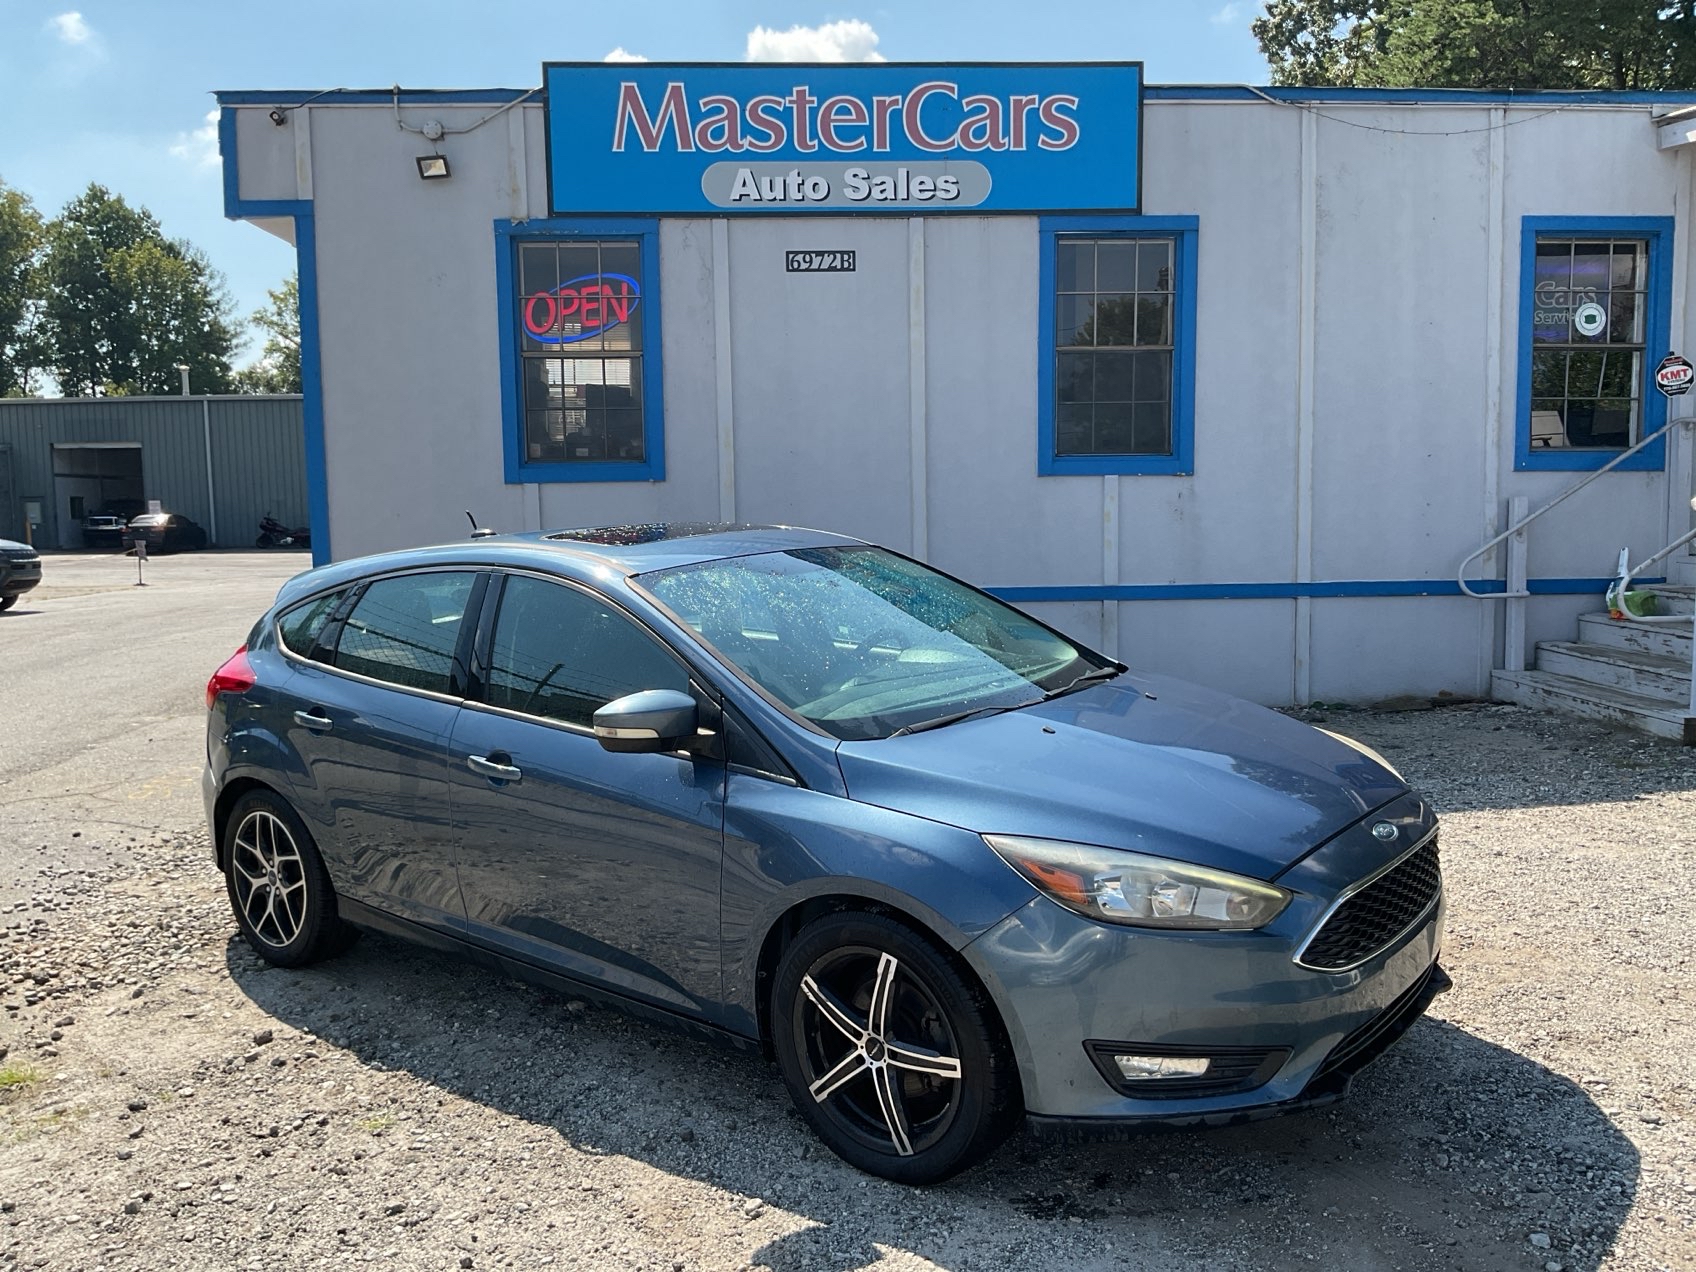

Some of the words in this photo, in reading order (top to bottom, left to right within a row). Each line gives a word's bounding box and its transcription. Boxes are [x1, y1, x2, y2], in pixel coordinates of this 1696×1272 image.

[611, 81, 1080, 153] MasterCars
[729, 168, 831, 202] Auto
[843, 167, 961, 201] Sales
[789, 252, 853, 270] 6972B
[525, 281, 629, 335] OPEN
[1534, 280, 1597, 308] Cars
[1660, 368, 1690, 382] KMT
